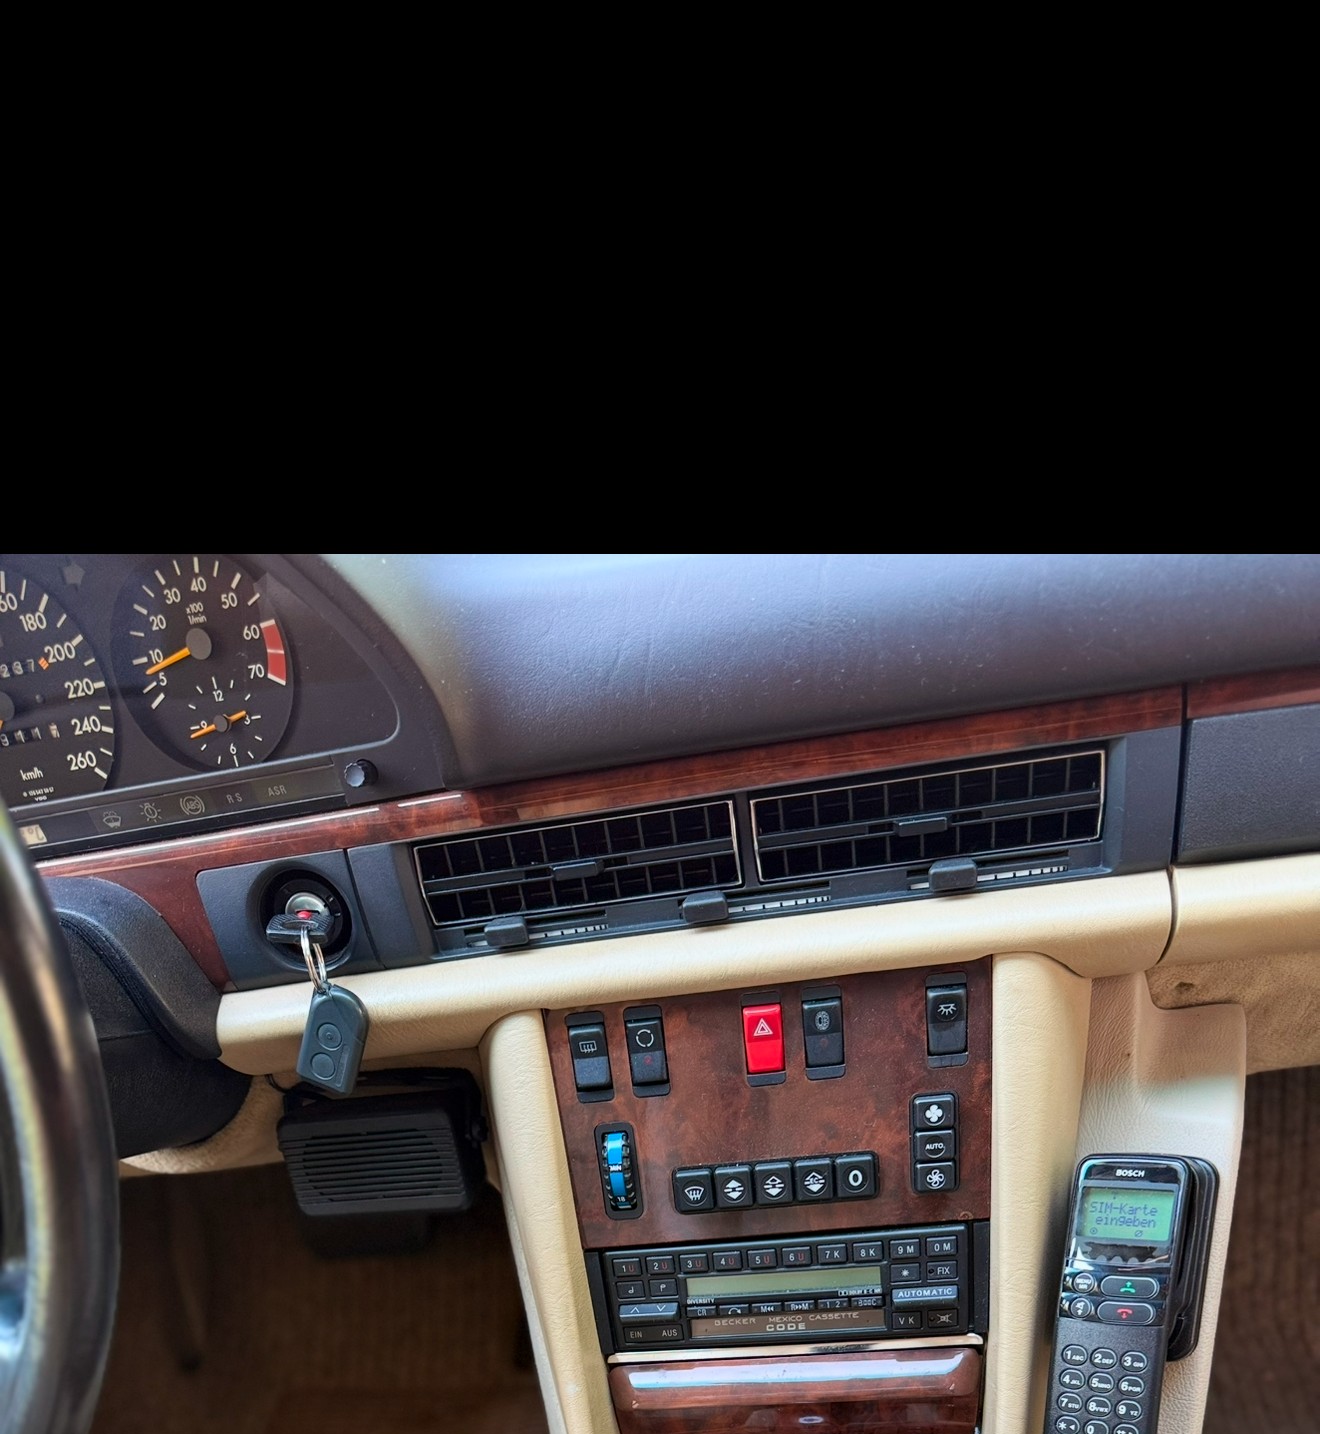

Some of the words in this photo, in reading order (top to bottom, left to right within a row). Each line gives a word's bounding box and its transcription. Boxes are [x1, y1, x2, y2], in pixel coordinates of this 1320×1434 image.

[190, 577, 206, 592] 40
[164, 588, 180, 604] 30
[221, 592, 238, 609] 50
[186, 602, 204, 614] x100
[19, 612, 47, 632] 180
[150, 615, 166, 630] 20
[243, 624, 260, 640] 60
[44, 642, 76, 663] 200
[149, 649, 163, 664] 10
[248, 664, 264, 679] 70
[159, 672, 167, 686] 5
[65, 678, 94, 698] 220
[213, 690, 224, 702] 12
[71, 716, 101, 735] 240
[244, 714, 250, 725] 3
[230, 743, 236, 754] 6
[67, 751, 96, 770] 260
[20, 767, 44, 781] km/h
[268, 785, 287, 797] ASR
[849, 1170, 862, 1186] 0
[1116, 1169, 1145, 1178] BOSCH
[1090, 1201, 1158, 1216] SIM-Karte
[1096, 1215, 1156, 1228] eingeben
[937, 1267, 950, 1275] FIX
[898, 1288, 953, 1298] AUTOMATIC
[714, 1318, 756, 1326] BECKER
[809, 1312, 860, 1320] CASSETTE
[662, 1329, 678, 1337] AUS
[766, 1323, 806, 1331] CODE
[630, 1331, 642, 1339] EIN
[1065, 1350, 1071, 1360] 1
[1094, 1354, 1101, 1363] 2
[1124, 1356, 1132, 1366] 3
[1063, 1374, 1070, 1384] 4
[1092, 1378, 1098, 1387] 5
[1121, 1382, 1128, 1391] 6
[1061, 1398, 1068, 1407] 7
[1088, 1402, 1096, 1411] 8
[1118, 1405, 1126, 1414] 9
[1087, 1426, 1094, 1434] 0
